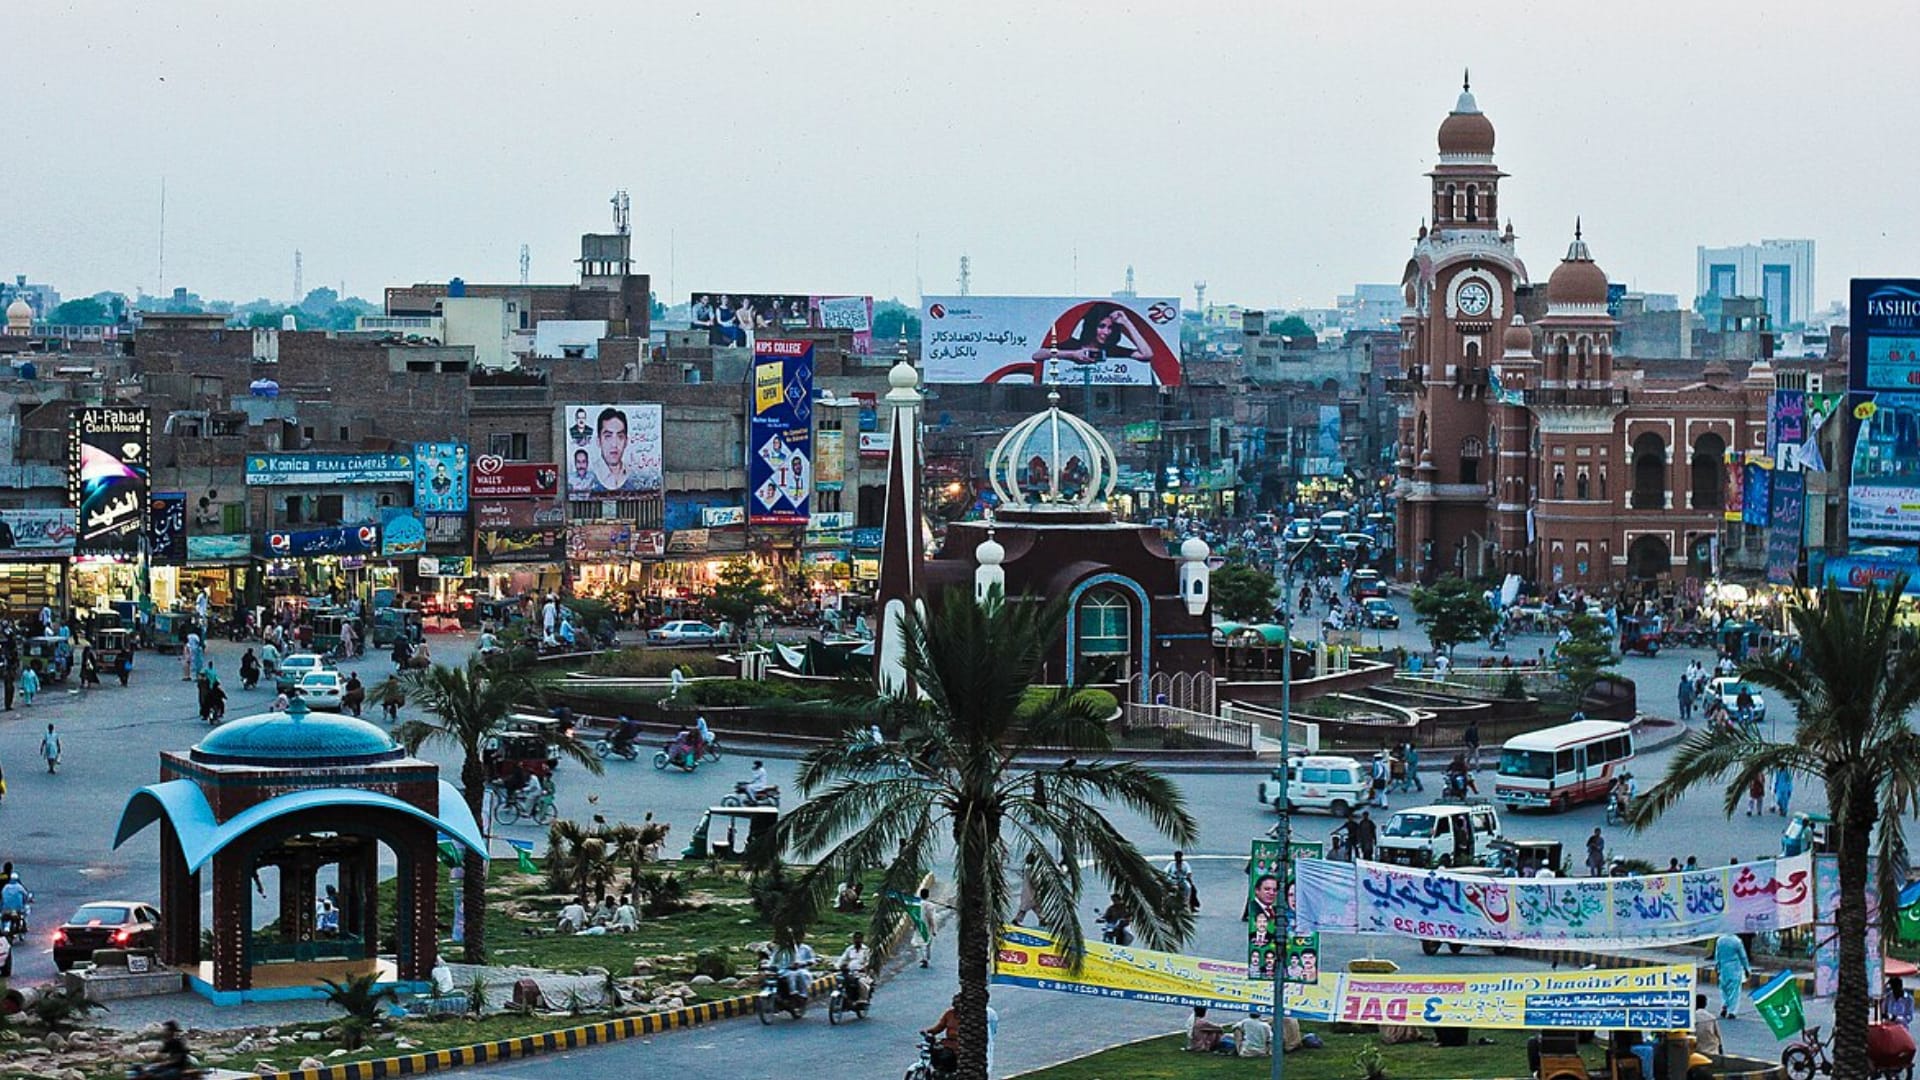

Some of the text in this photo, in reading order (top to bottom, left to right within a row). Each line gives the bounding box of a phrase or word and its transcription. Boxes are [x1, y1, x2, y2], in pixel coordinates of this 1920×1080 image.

[756, 341, 802, 354] KIPS COLLEGE
[1113, 363, 1128, 374] 20
[83, 409, 145, 424] Al-Fahad
[85, 422, 141, 433] Cloth House
[269, 458, 310, 471] Konica
[316, 460, 338, 471] FILM
